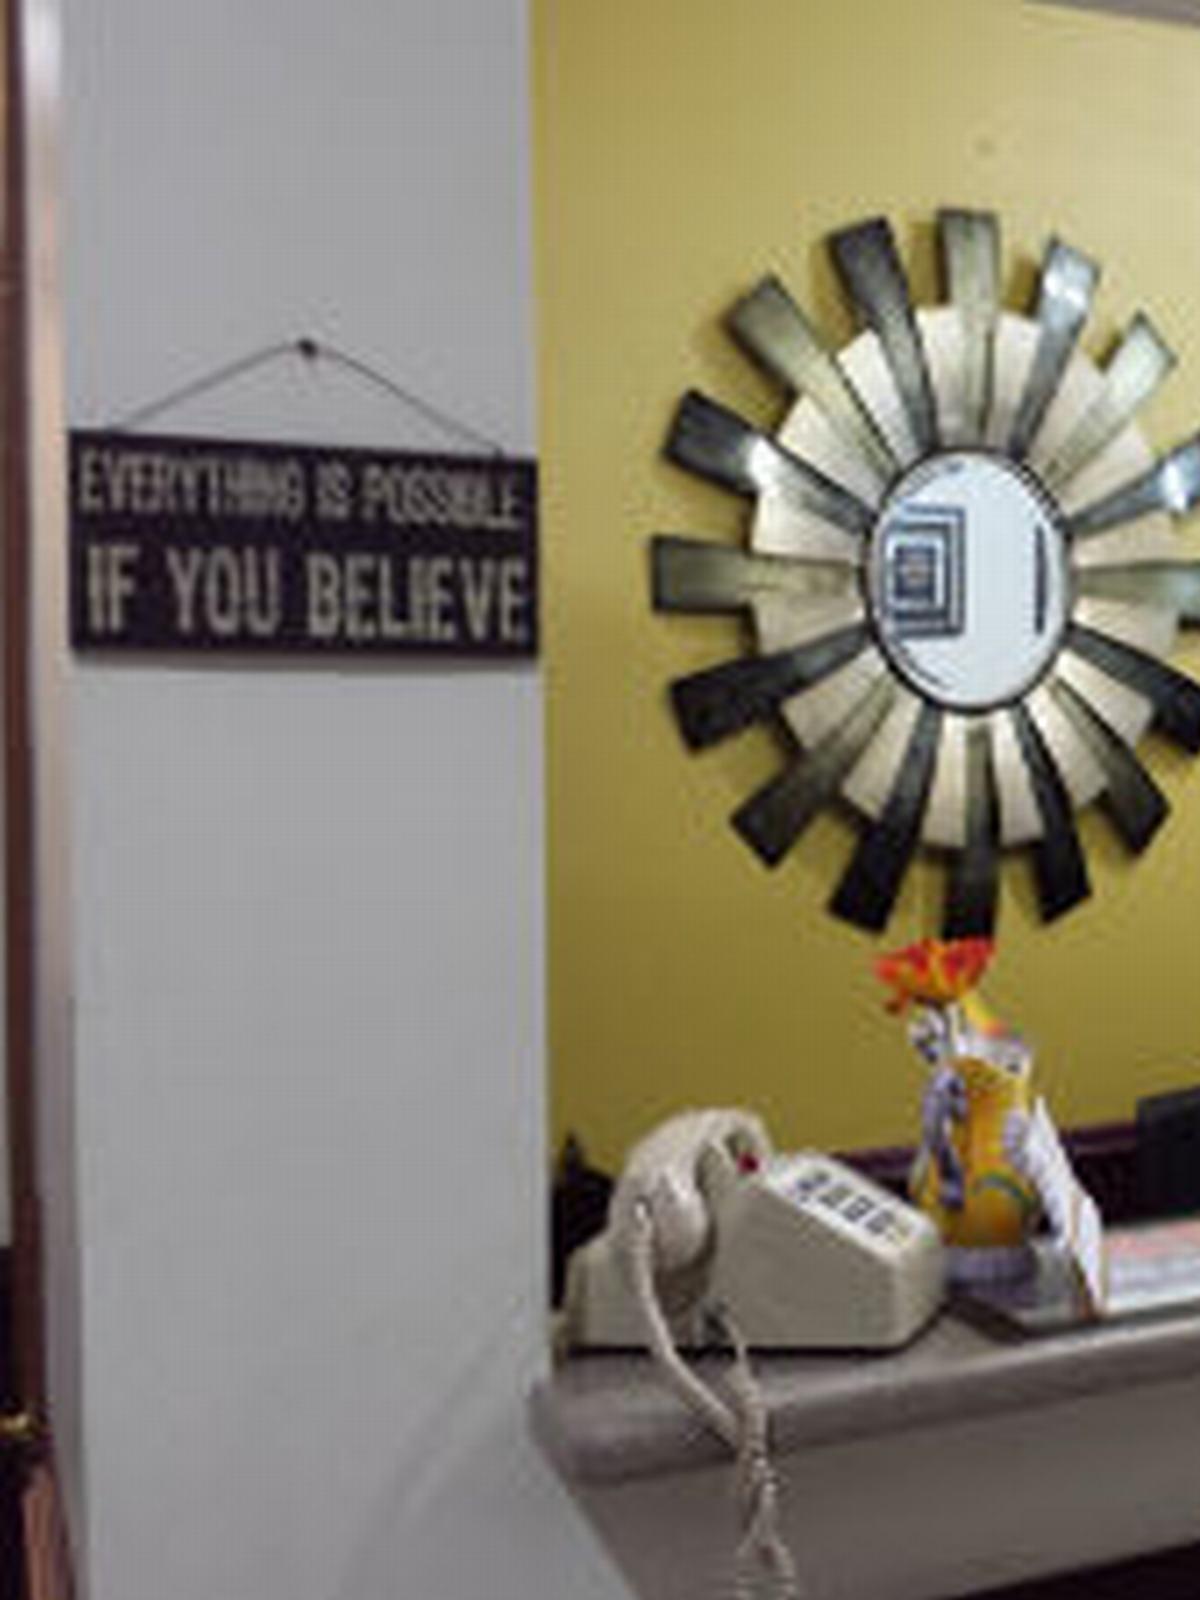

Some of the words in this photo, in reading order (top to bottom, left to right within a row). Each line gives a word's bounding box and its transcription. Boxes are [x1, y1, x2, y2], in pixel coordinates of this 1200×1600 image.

[80, 447, 305, 521] EVERYTHING
[315, 459, 352, 521] IS
[361, 462, 524, 530] POSSIBLE
[87, 544, 140, 633] IF
[166, 546, 282, 635] YOU
[307, 553, 528, 642] BELIEVE
